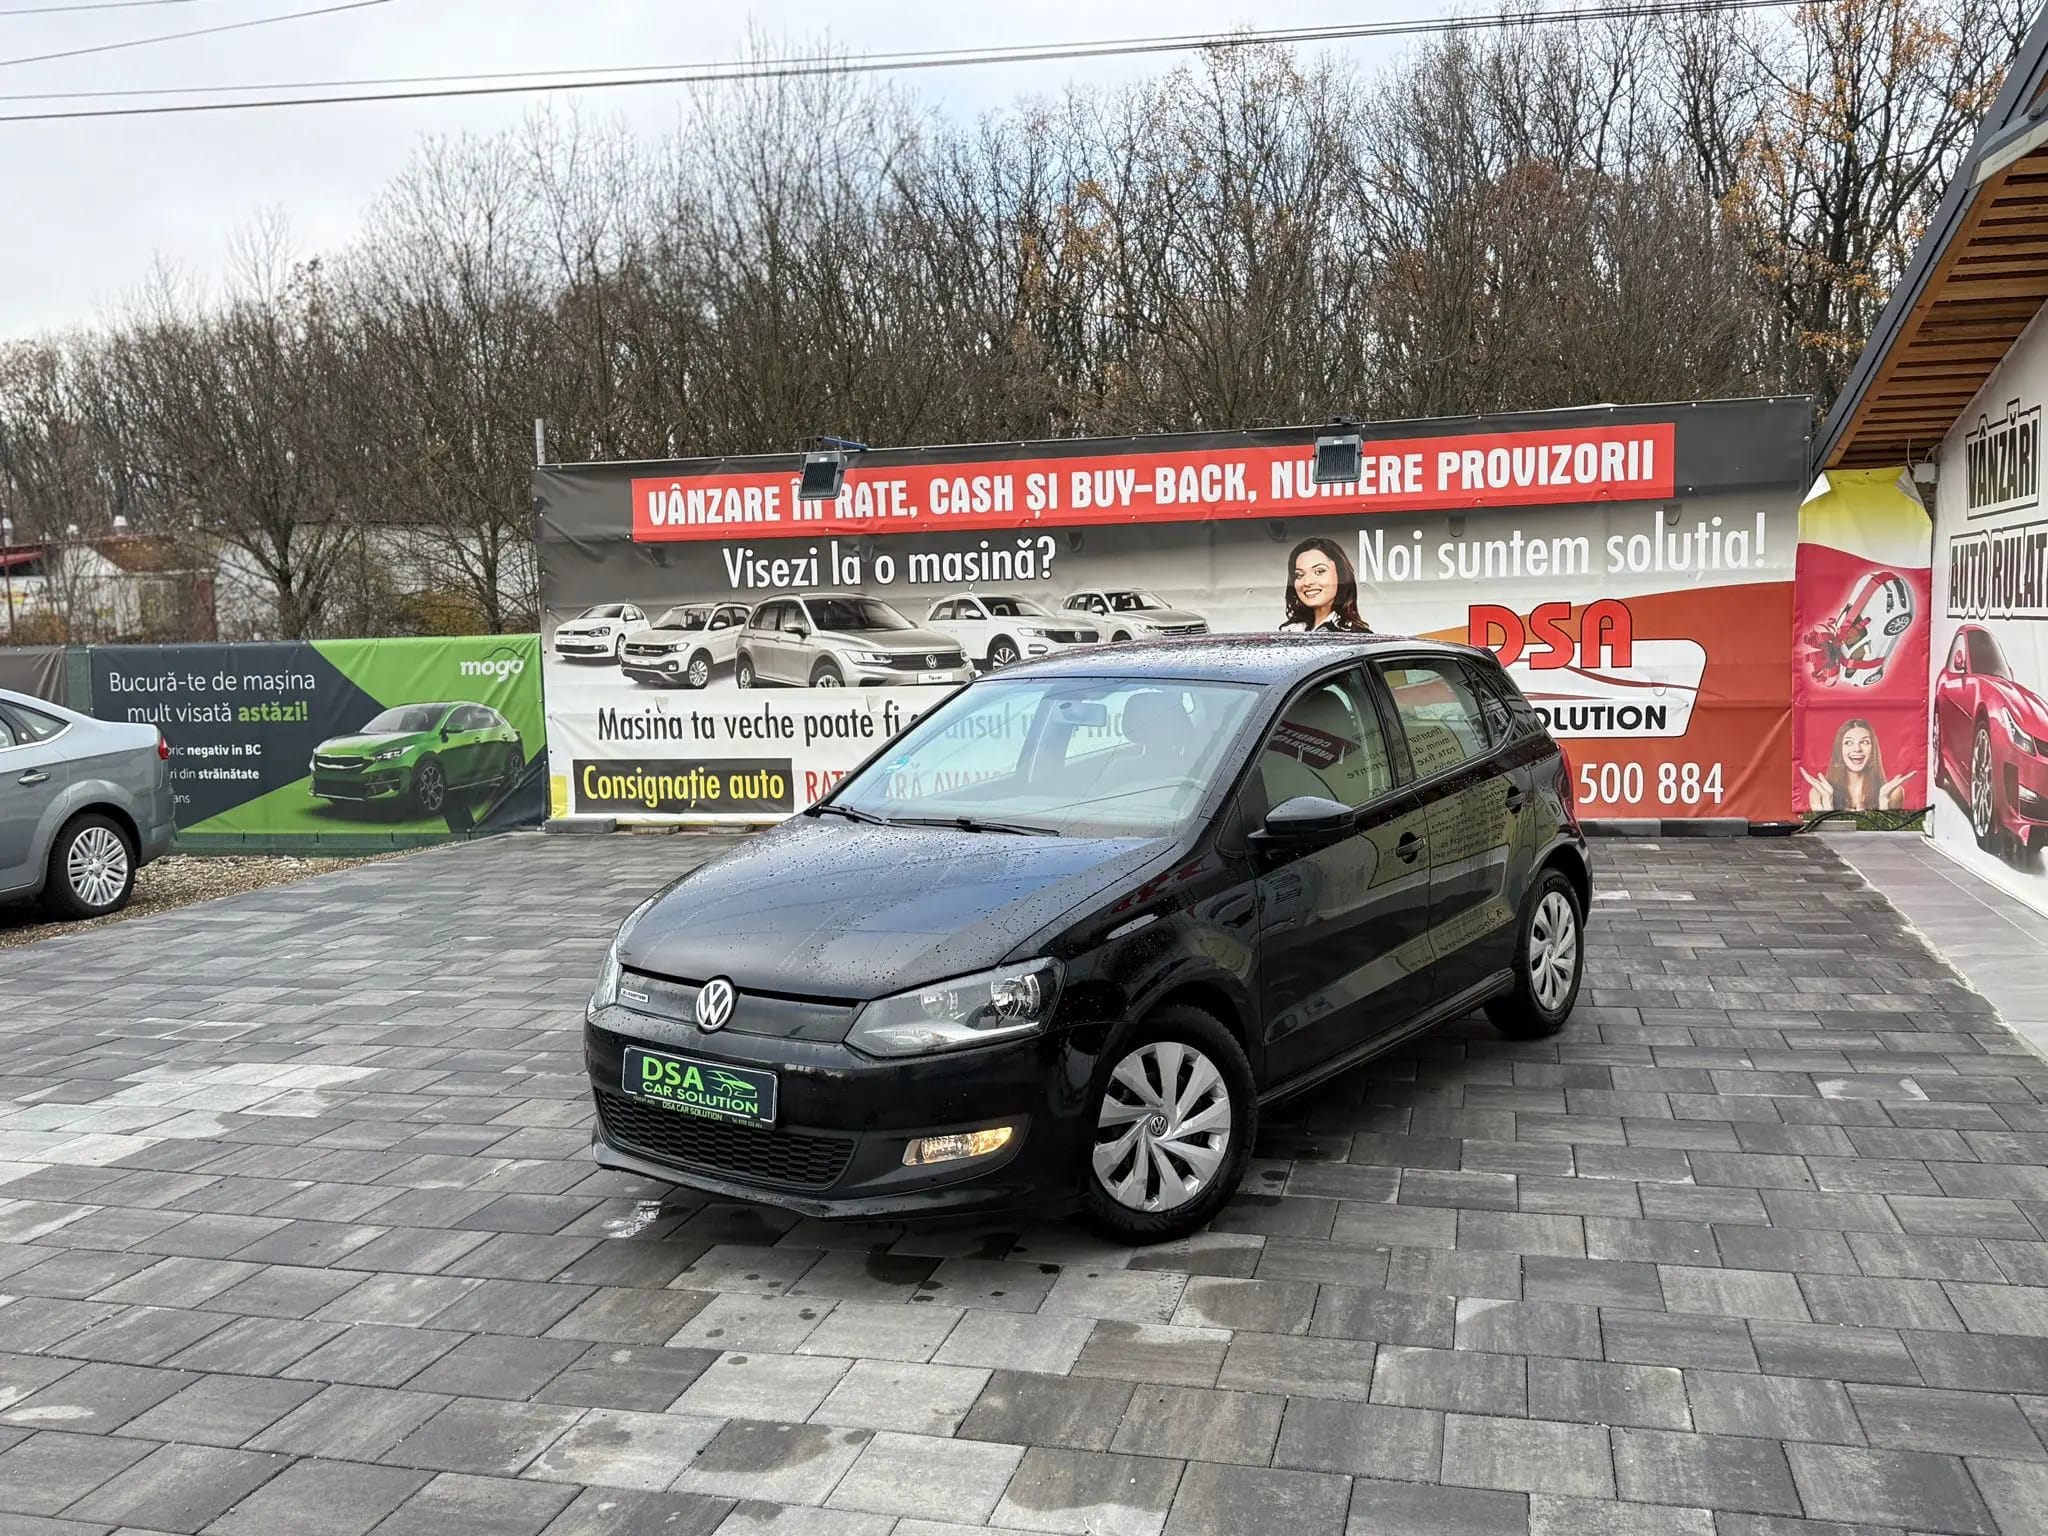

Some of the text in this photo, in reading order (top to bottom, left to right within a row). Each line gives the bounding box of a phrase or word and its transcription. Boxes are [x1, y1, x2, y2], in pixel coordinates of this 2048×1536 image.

[1967, 410, 2040, 510] VÂNZĂRI
[648, 482, 781, 526] VÂNZARE
[835, 478, 918, 519] RATE,
[929, 474, 1014, 515] CASH
[1026, 472, 1058, 519] ȘI
[1071, 463, 1257, 509] BUY-BACK,
[1436, 438, 1655, 492] PROVIZORII
[722, 535, 1057, 593] Visezi la o mașină?
[1358, 510, 1767, 583] Noi suntem soluția!
[1949, 532, 2048, 610] AUTO RULAT
[1467, 598, 1634, 670] DSA
[109, 669, 316, 695] Bucură-te de mașina
[460, 657, 525, 682] mogo
[127, 701, 309, 724] mult visată astăzi!
[691, 710, 716, 740] ta
[723, 702, 795, 740] veche
[803, 708, 874, 748] poate
[883, 699, 900, 738] fi
[1533, 704, 1667, 731] OLUTION
[187, 744, 230, 758] negativ
[231, 744, 243, 756] in
[245, 743, 262, 756] BC
[179, 767, 196, 780] din
[198, 767, 260, 780] străinătate
[583, 764, 785, 808] Consignație auto
[1578, 762, 1724, 805] 500 884
[641, 1055, 705, 1092] DSA
[642, 1081, 673, 1098] CAR
[676, 1088, 759, 1115] SOLUTION
[662, 1101, 723, 1121] DSA CAR SOLUTION
